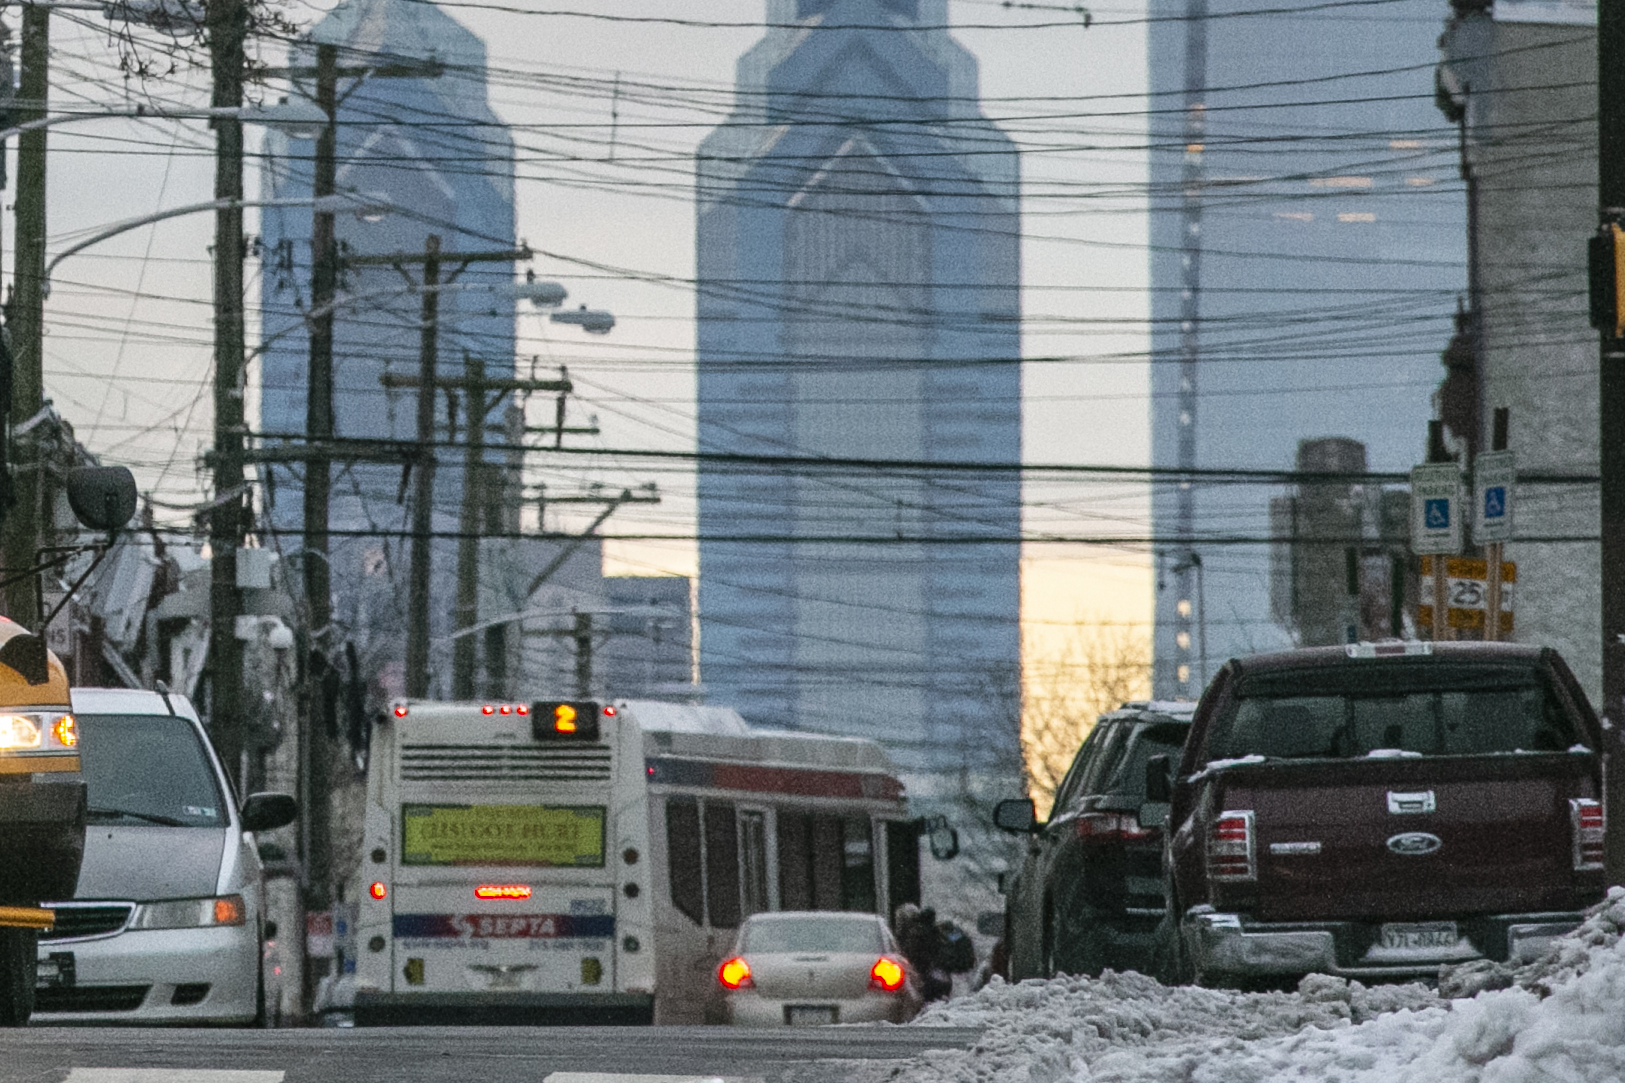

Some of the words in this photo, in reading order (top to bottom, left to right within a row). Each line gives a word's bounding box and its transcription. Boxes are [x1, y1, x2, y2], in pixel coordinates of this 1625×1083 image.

[1453, 580, 1481, 605] 25
[554, 704, 577, 734] 2
[478, 917, 555, 935] SEPTA
